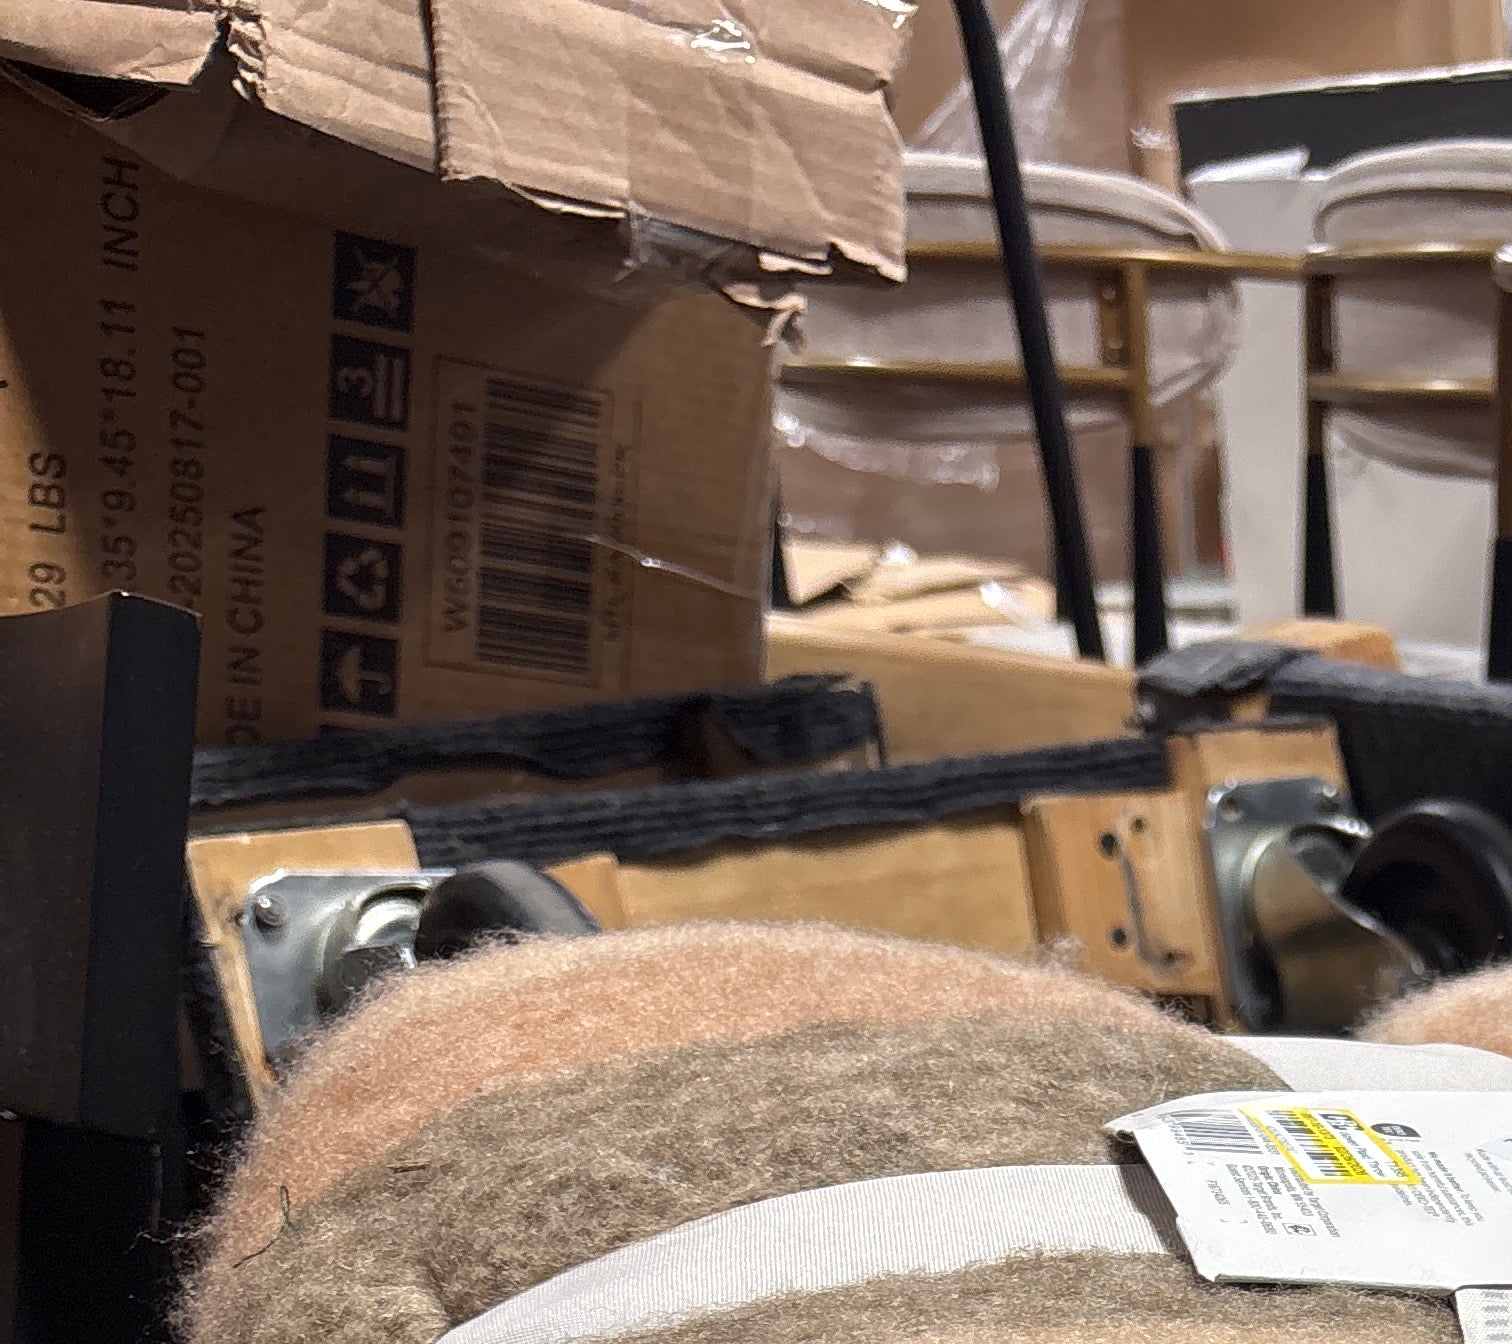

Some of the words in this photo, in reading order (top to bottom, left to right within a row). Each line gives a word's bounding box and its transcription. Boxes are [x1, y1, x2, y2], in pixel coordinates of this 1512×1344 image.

[101, 155, 141, 272] INCH
[27, 452, 68, 536] LBS
[226, 505, 266, 637] CHINA
[228, 645, 264, 686] IN
